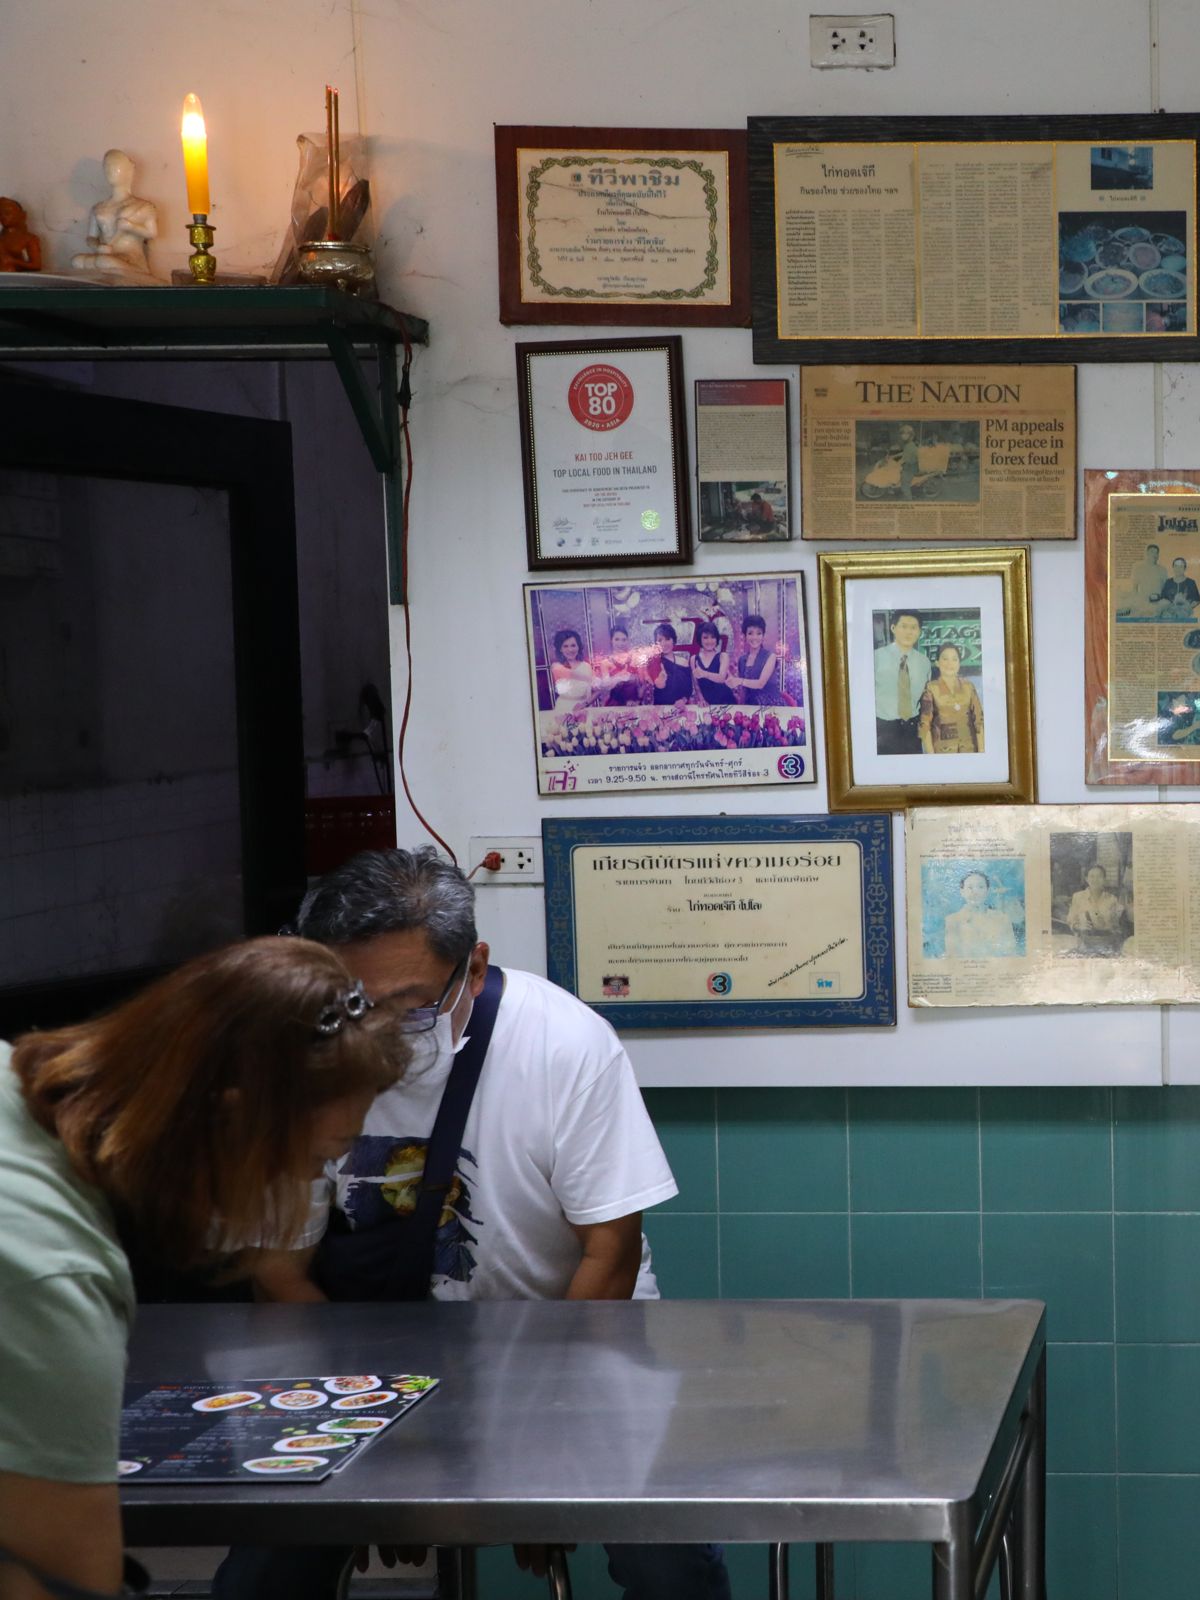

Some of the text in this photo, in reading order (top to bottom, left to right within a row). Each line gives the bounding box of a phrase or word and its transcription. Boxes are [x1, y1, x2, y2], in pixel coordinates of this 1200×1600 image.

[584, 382, 618, 397] TOP
[855, 381, 1021, 404] THE NATION
[588, 396, 616, 416] 80
[985, 418, 1065, 435] PM appeals
[985, 435, 1065, 452] for peace in
[575, 452, 587, 462] KAI
[620, 450, 634, 460] GEE
[990, 451, 1059, 465] forex feud
[553, 464, 658, 478] TOP LOCAL FOOD IN THAILAND
[605, 774, 647, 784] 9.25-9.50
[763, 768, 769, 777] 3
